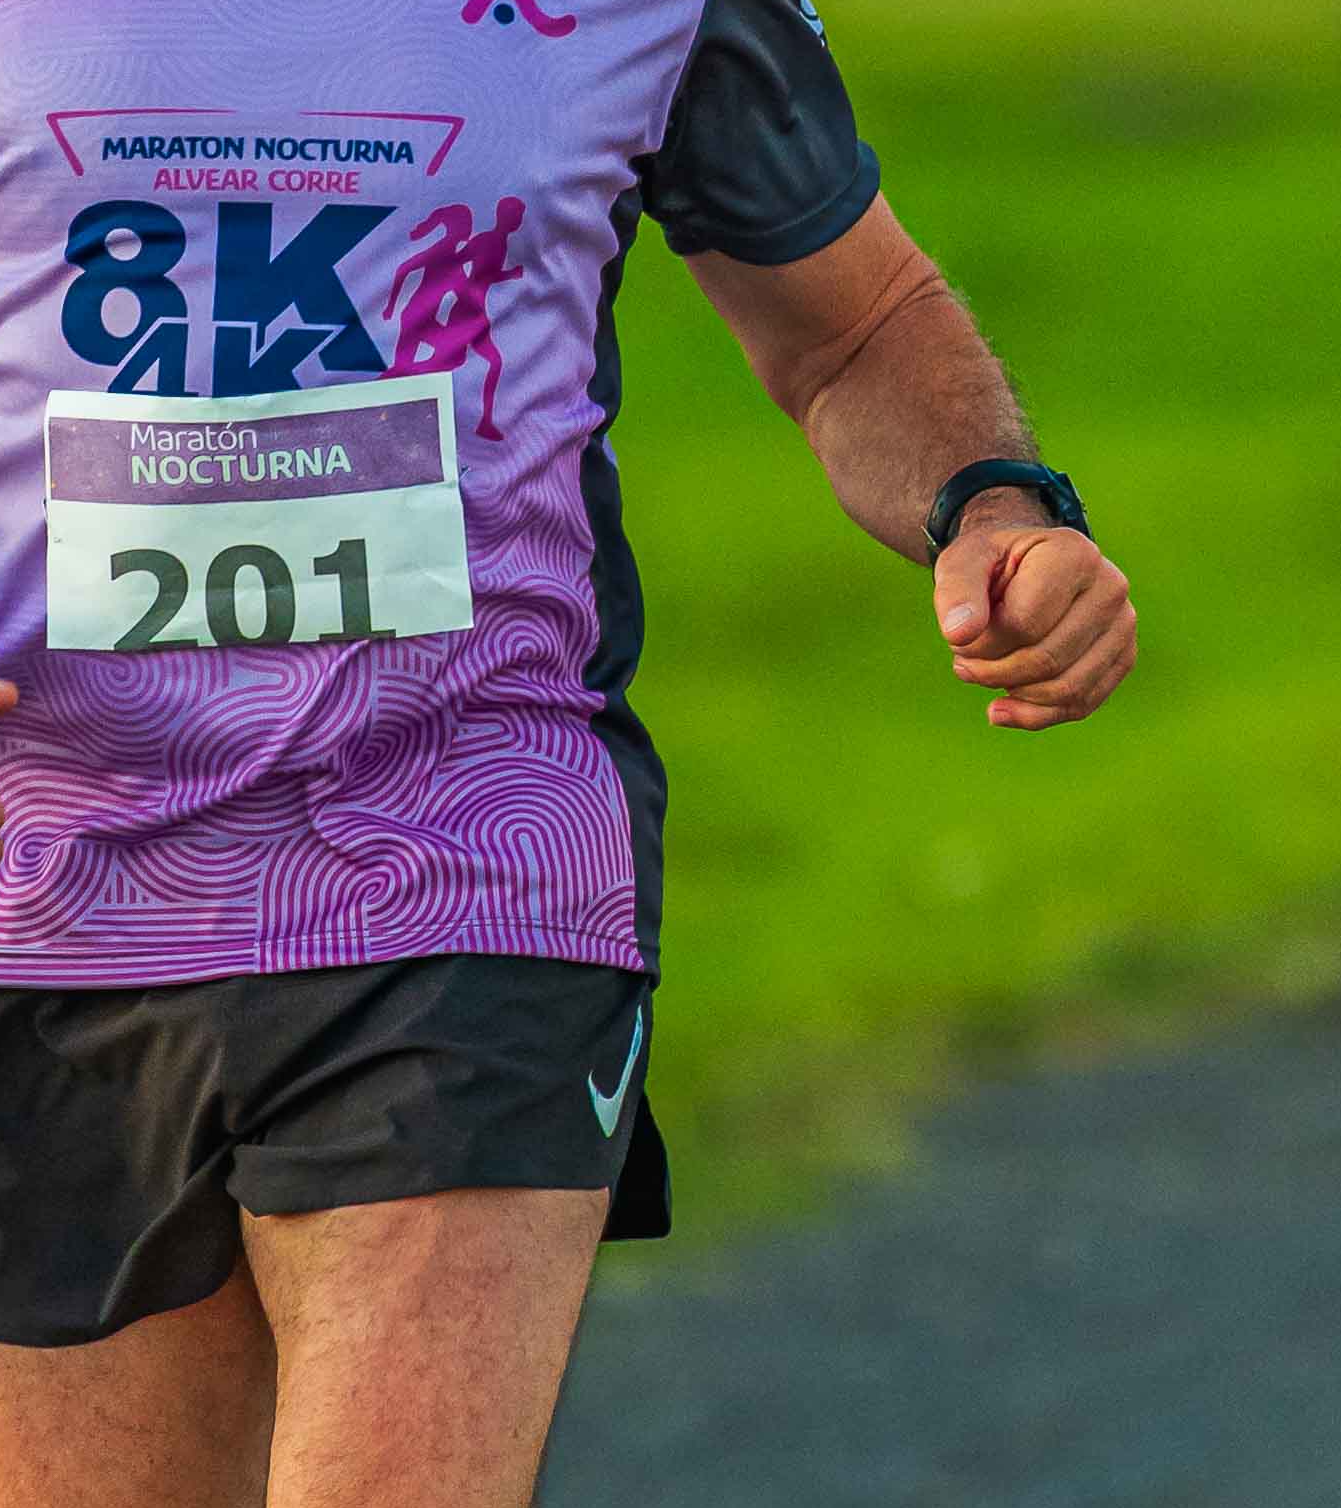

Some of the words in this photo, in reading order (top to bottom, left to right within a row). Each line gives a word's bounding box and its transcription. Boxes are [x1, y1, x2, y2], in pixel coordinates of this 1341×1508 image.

[102, 136, 245, 163] MARATON
[255, 137, 414, 165] NOCTURNA
[153, 168, 259, 192] ALVEAR
[267, 169, 360, 194] CORRE
[60, 200, 399, 372] 8K
[131, 421, 258, 452] Maratón
[131, 445, 352, 485] NOCTURNA
[110, 538, 396, 651] 201
